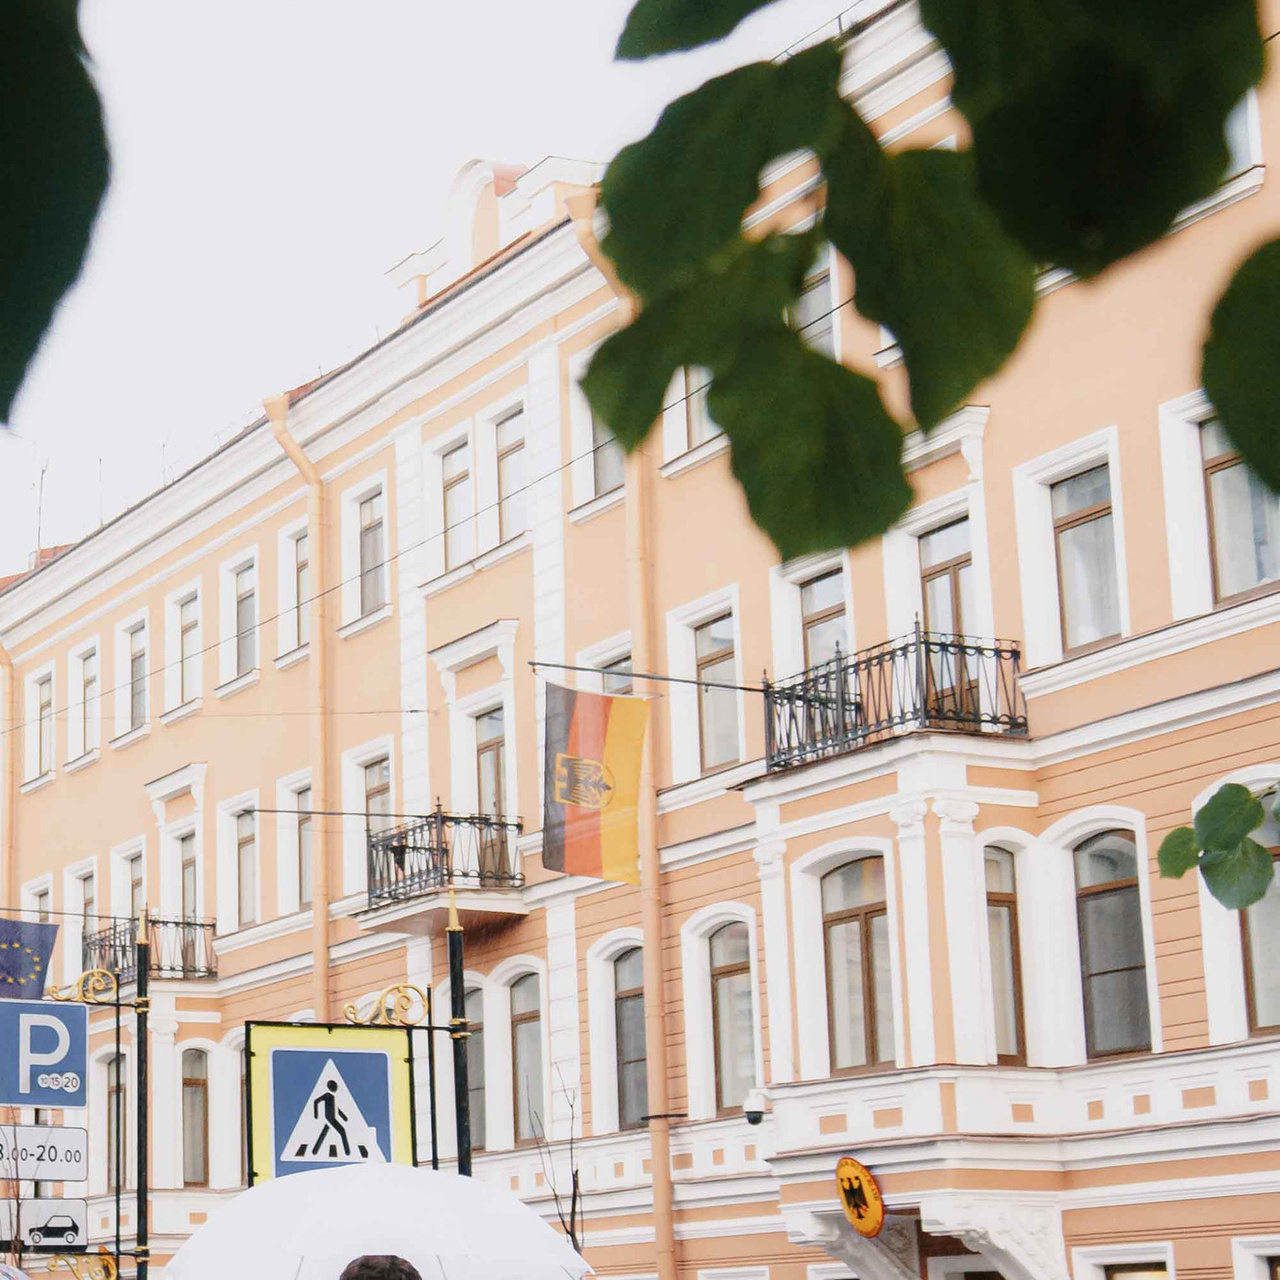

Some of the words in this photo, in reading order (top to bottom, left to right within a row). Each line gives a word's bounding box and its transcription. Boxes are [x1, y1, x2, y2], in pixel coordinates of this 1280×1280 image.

[19, 1013, 70, 1094] P
[51, 1076, 60, 1087] 15
[64, 1076, 79, 1088] 20
